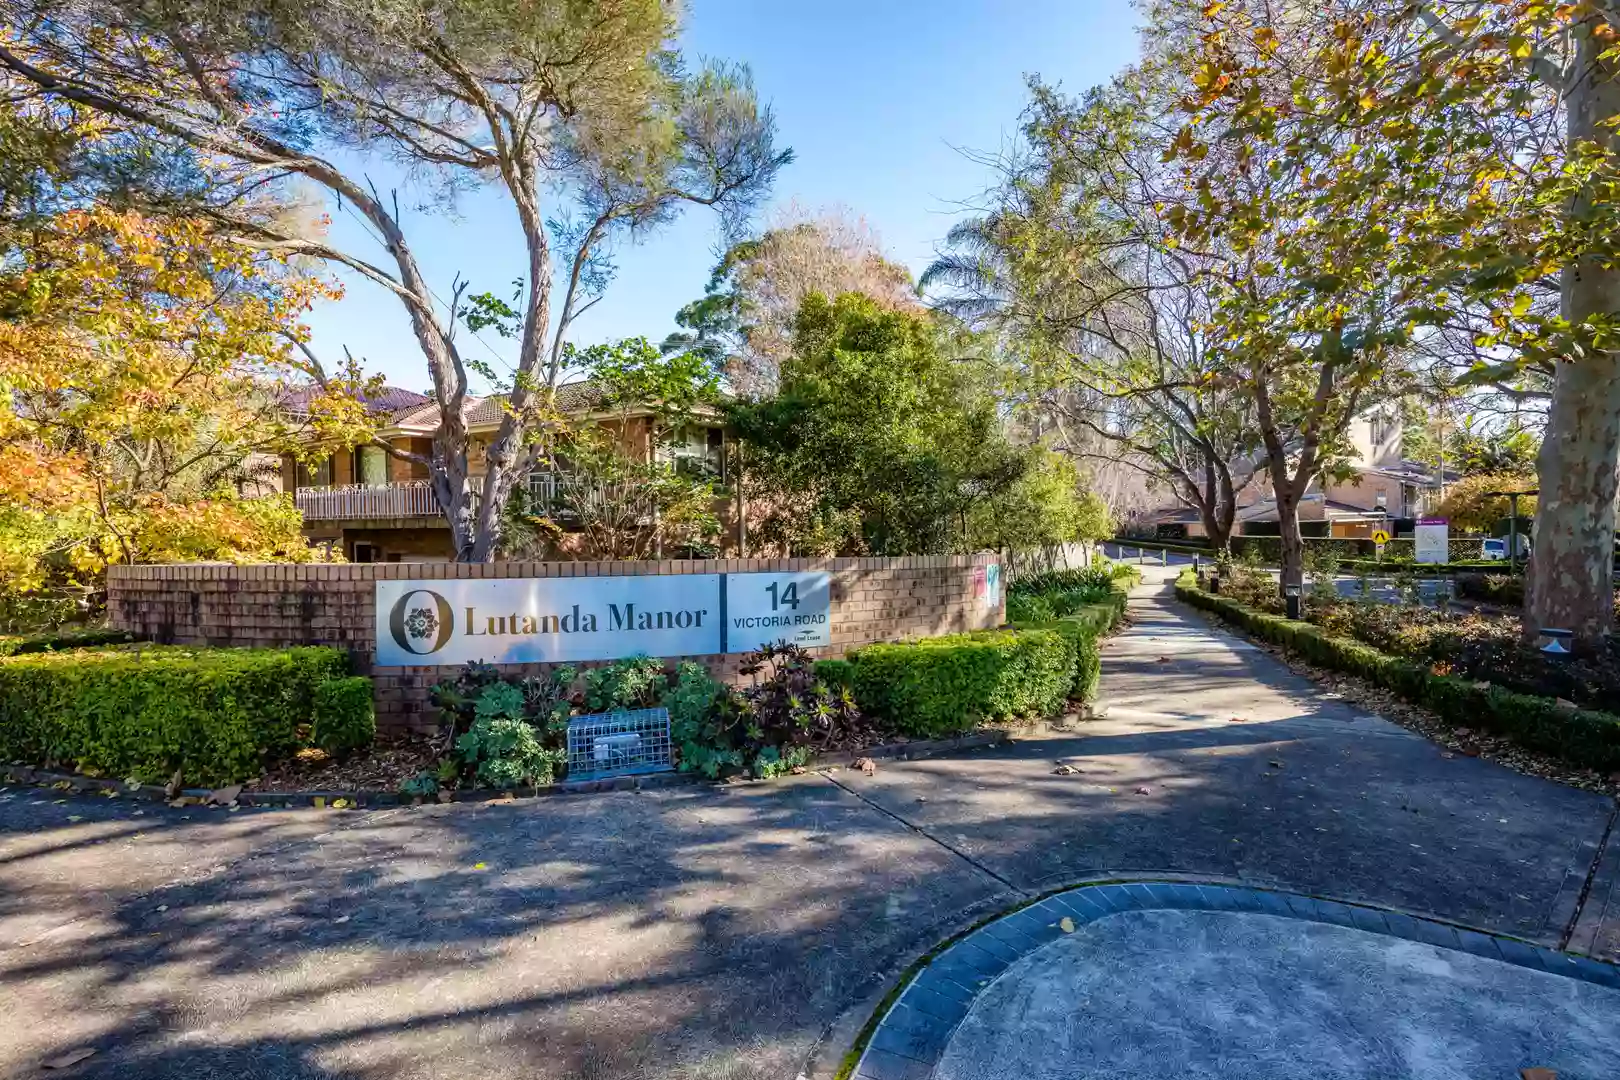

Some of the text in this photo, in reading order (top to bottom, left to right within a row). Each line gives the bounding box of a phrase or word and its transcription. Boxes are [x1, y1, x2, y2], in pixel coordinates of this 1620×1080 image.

[765, 582, 800, 611] 14
[464, 603, 708, 636] Lutanda Manor
[734, 614, 826, 629] VICTORIA ROAD
